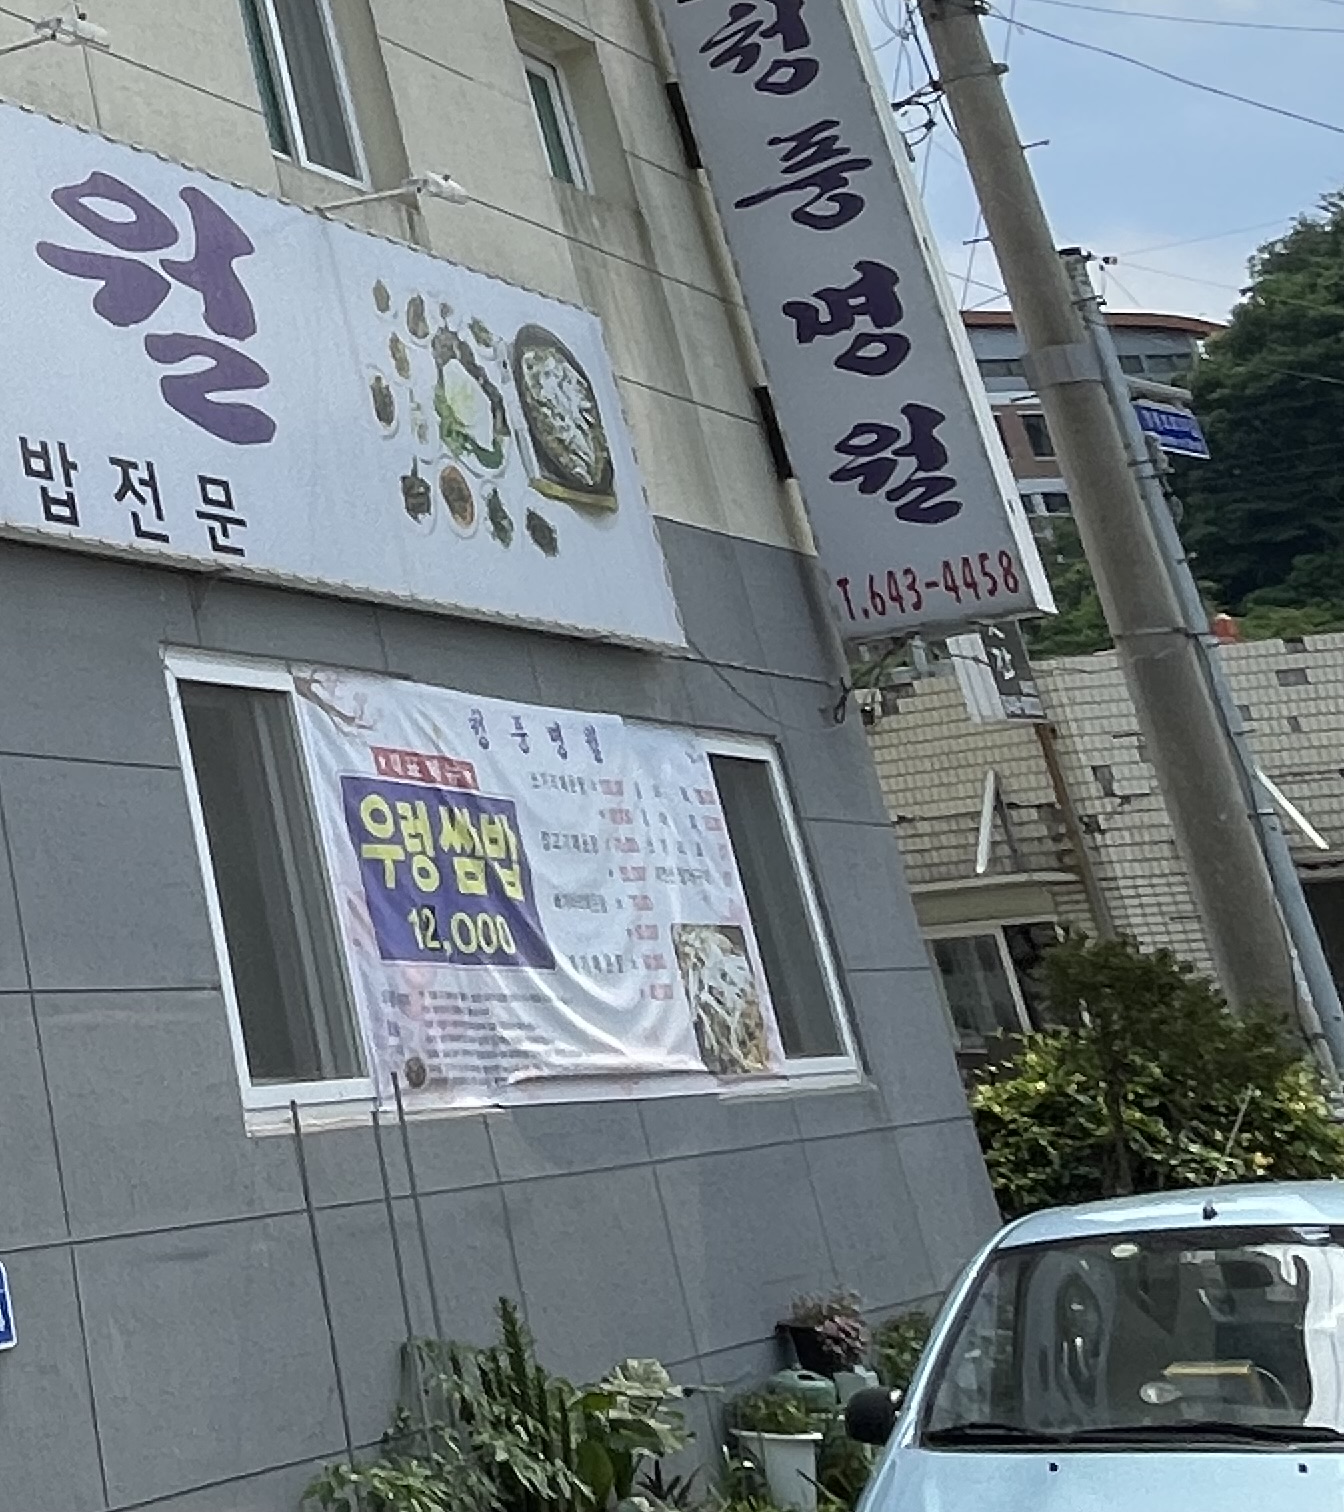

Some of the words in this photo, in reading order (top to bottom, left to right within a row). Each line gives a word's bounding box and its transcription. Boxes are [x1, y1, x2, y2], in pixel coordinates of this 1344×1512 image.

[836, 548, 1020, 622] T.643-4458
[359, 793, 525, 902] 우렁쌈밥
[407, 905, 517, 956] 12,000
